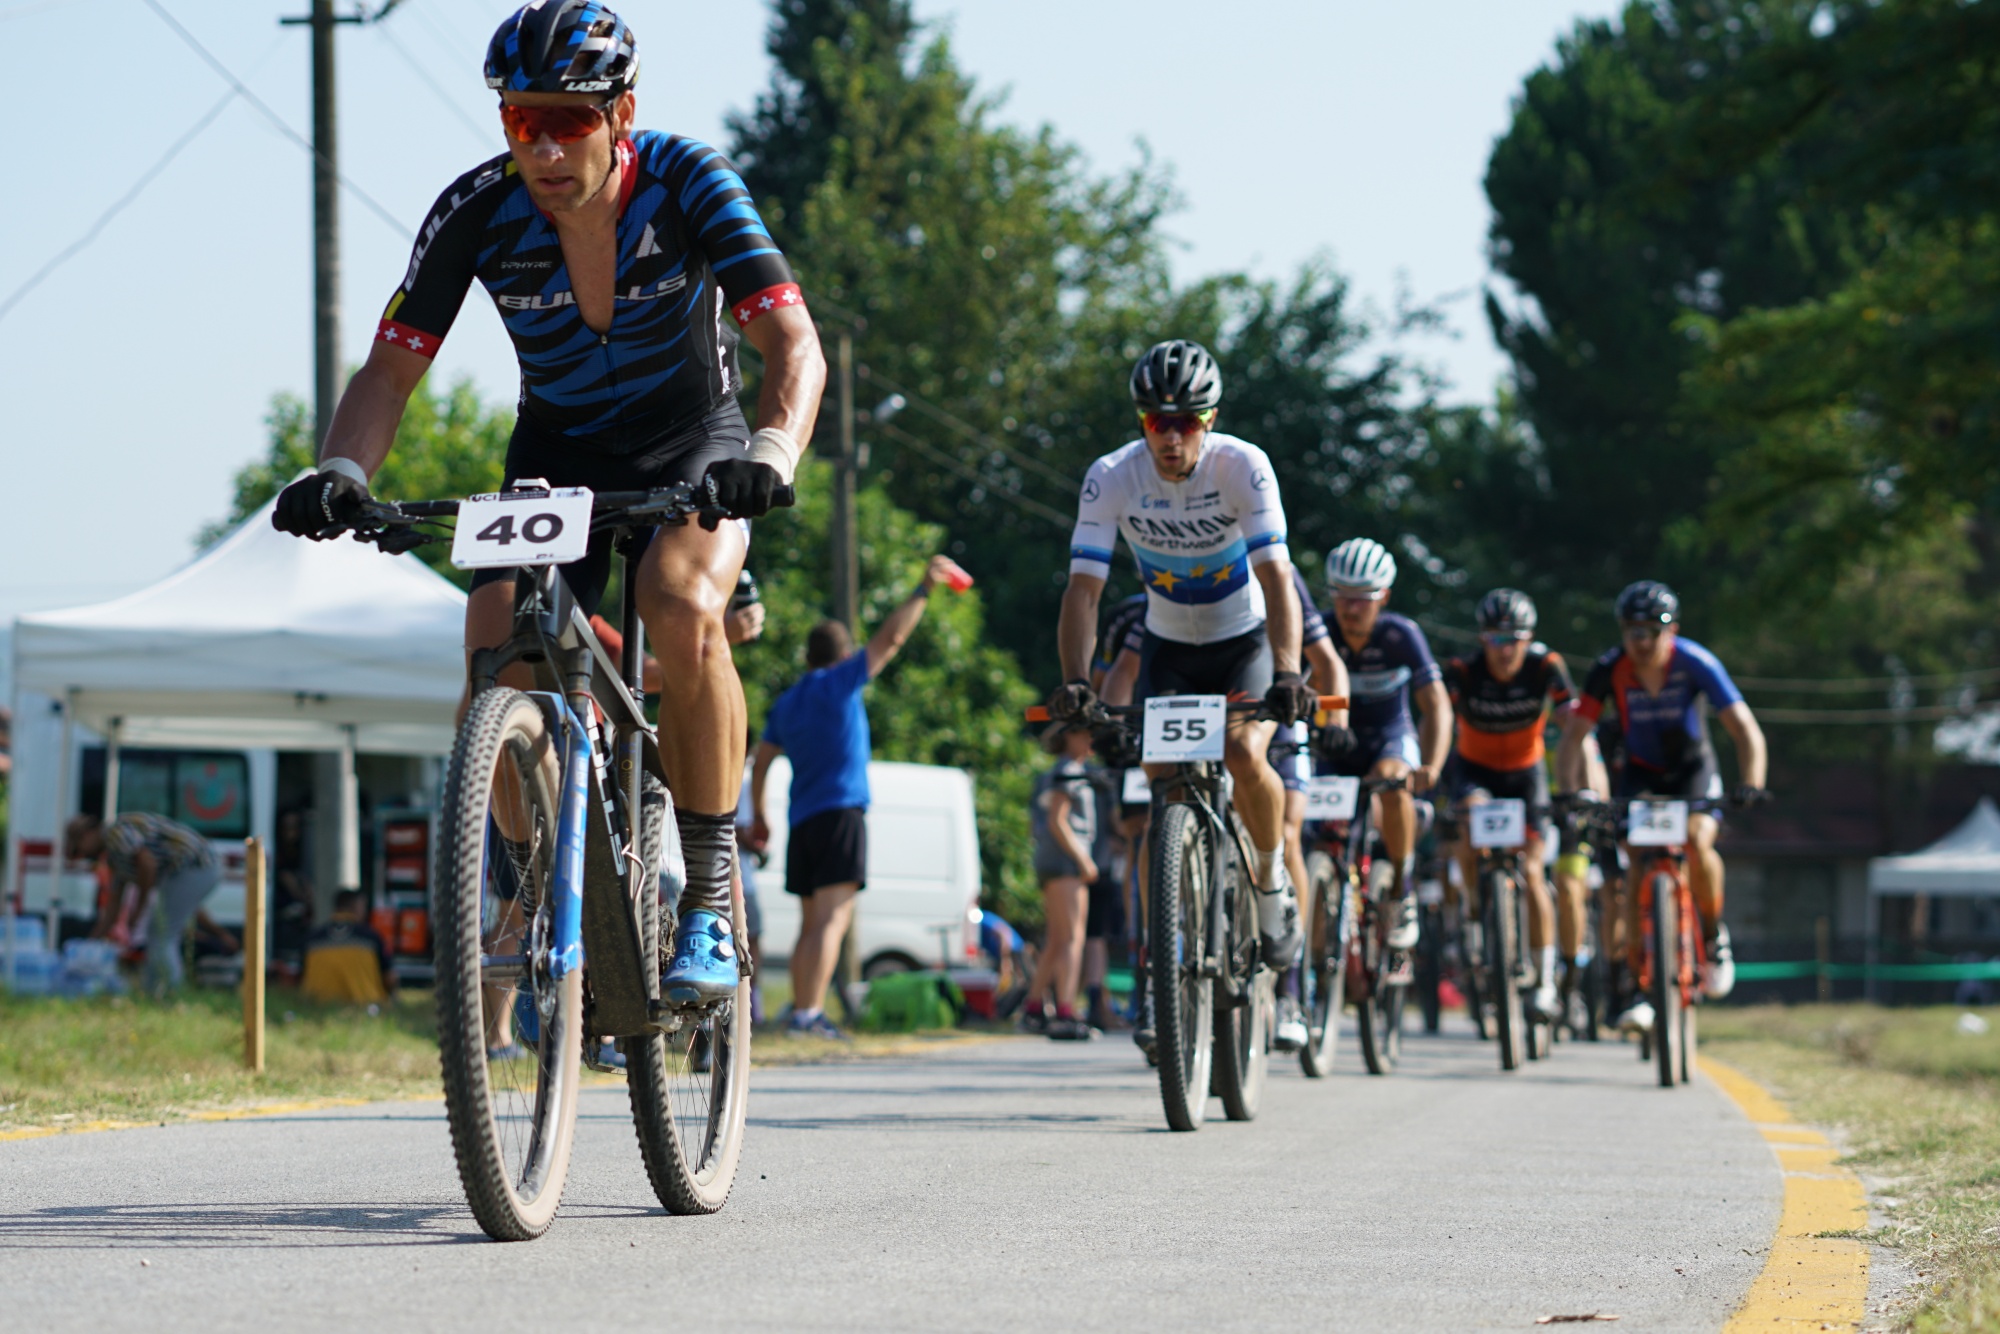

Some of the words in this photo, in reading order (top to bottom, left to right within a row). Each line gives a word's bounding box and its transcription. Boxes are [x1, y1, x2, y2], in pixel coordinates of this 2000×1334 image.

[565, 81, 612, 92] LAZER
[404, 165, 502, 292] BULLS
[321, 482, 335, 521] ERGON
[476, 513, 564, 545] 40
[1128, 513, 1238, 538] CANYON
[1161, 719, 1207, 742] 55
